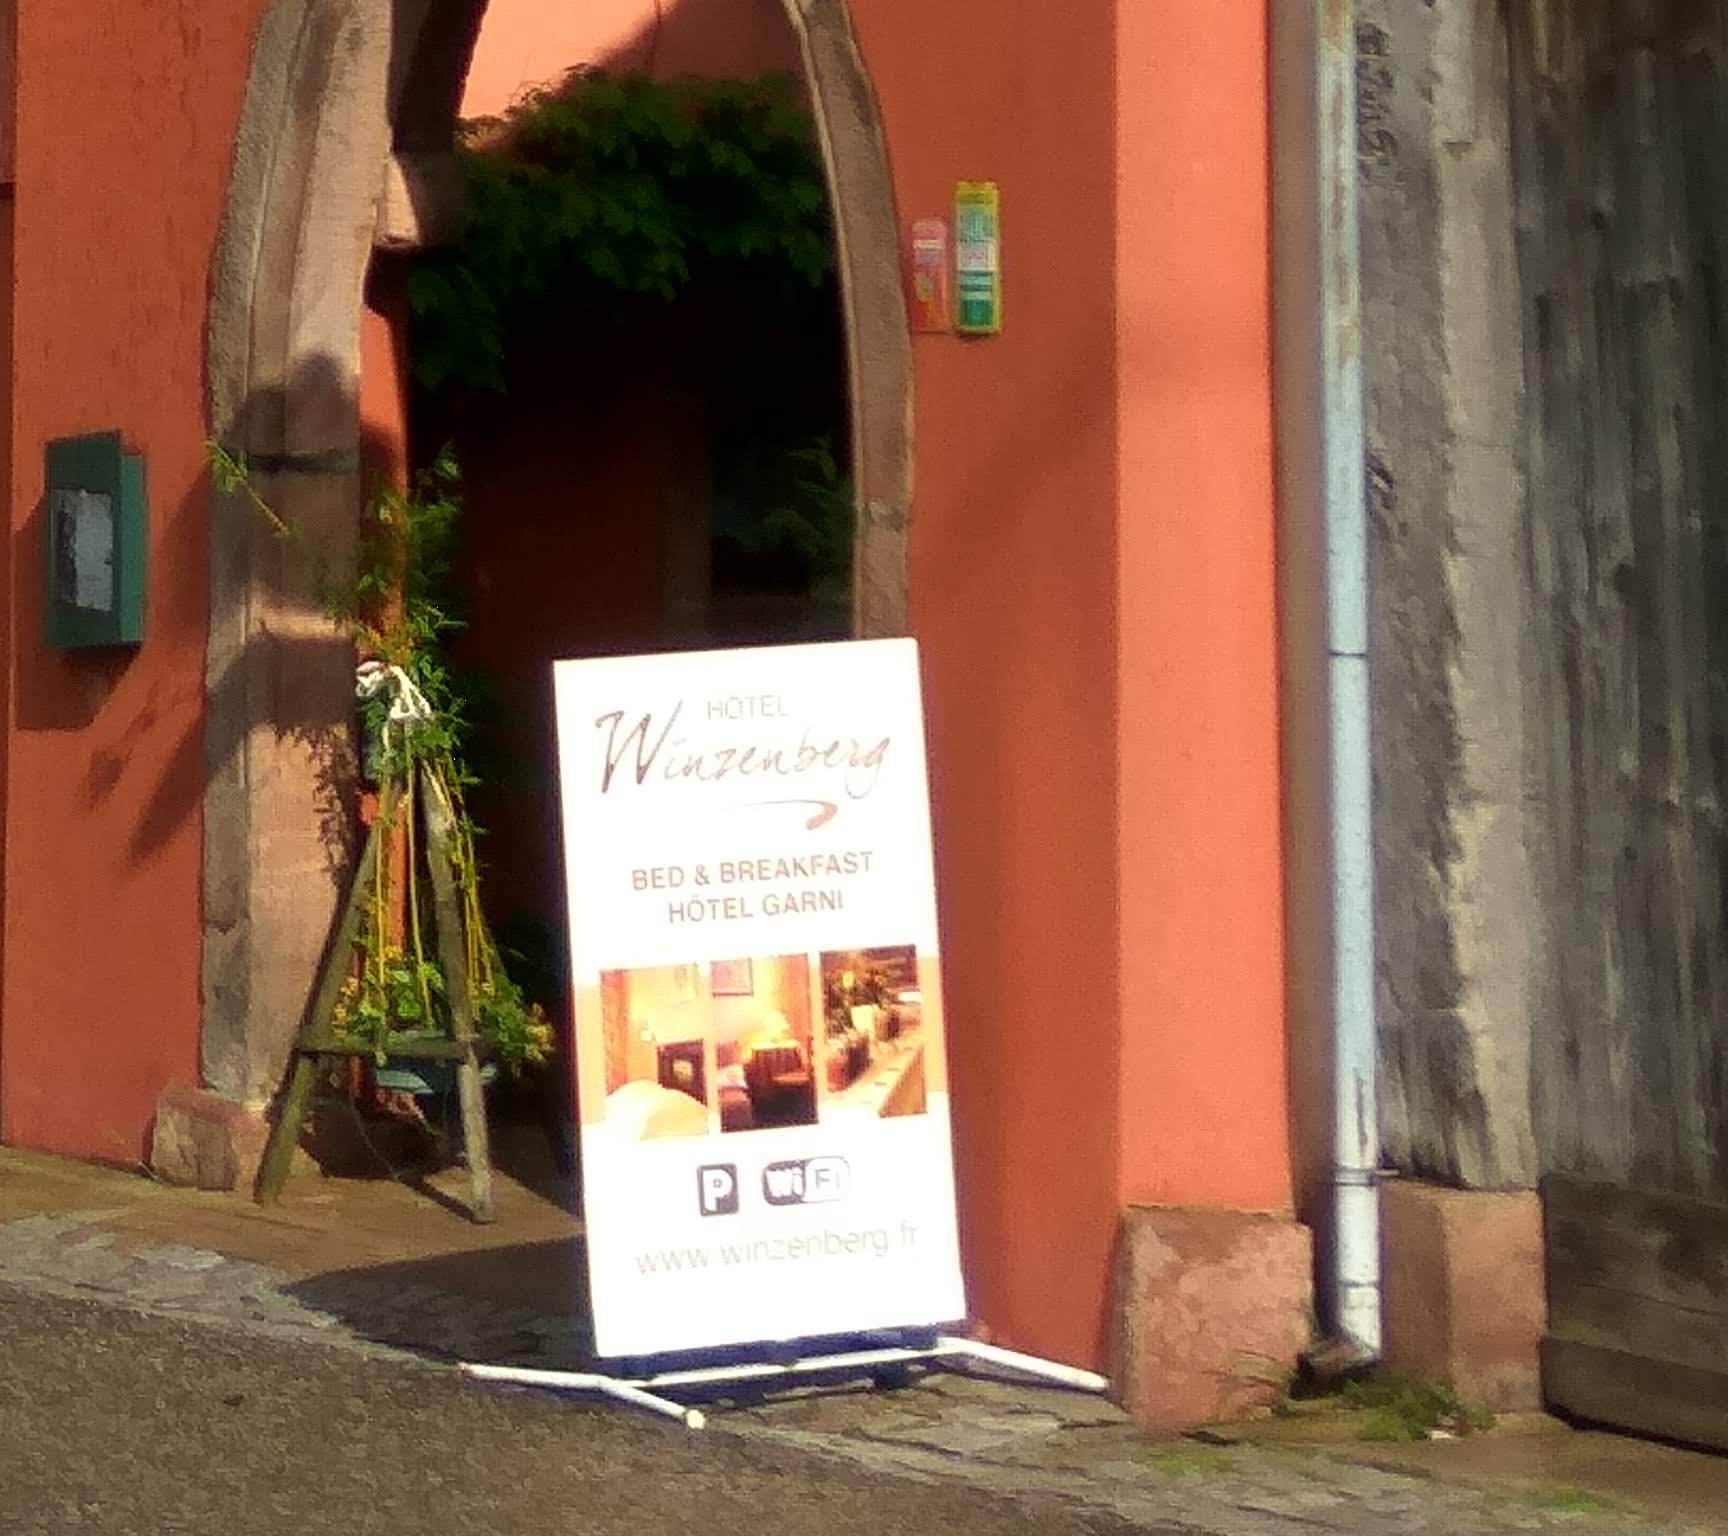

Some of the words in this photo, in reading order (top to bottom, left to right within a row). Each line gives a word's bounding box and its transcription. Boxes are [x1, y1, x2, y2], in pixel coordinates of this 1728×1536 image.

[594, 699, 892, 800] Winzenberg
[631, 865, 686, 891] BED
[694, 863, 711, 887] &
[719, 850, 874, 885] BREAKFAST
[668, 893, 755, 924] HÔTEL
[762, 889, 844, 917] GARNI
[635, 1222, 917, 1274] wwwwinzenbergfr
